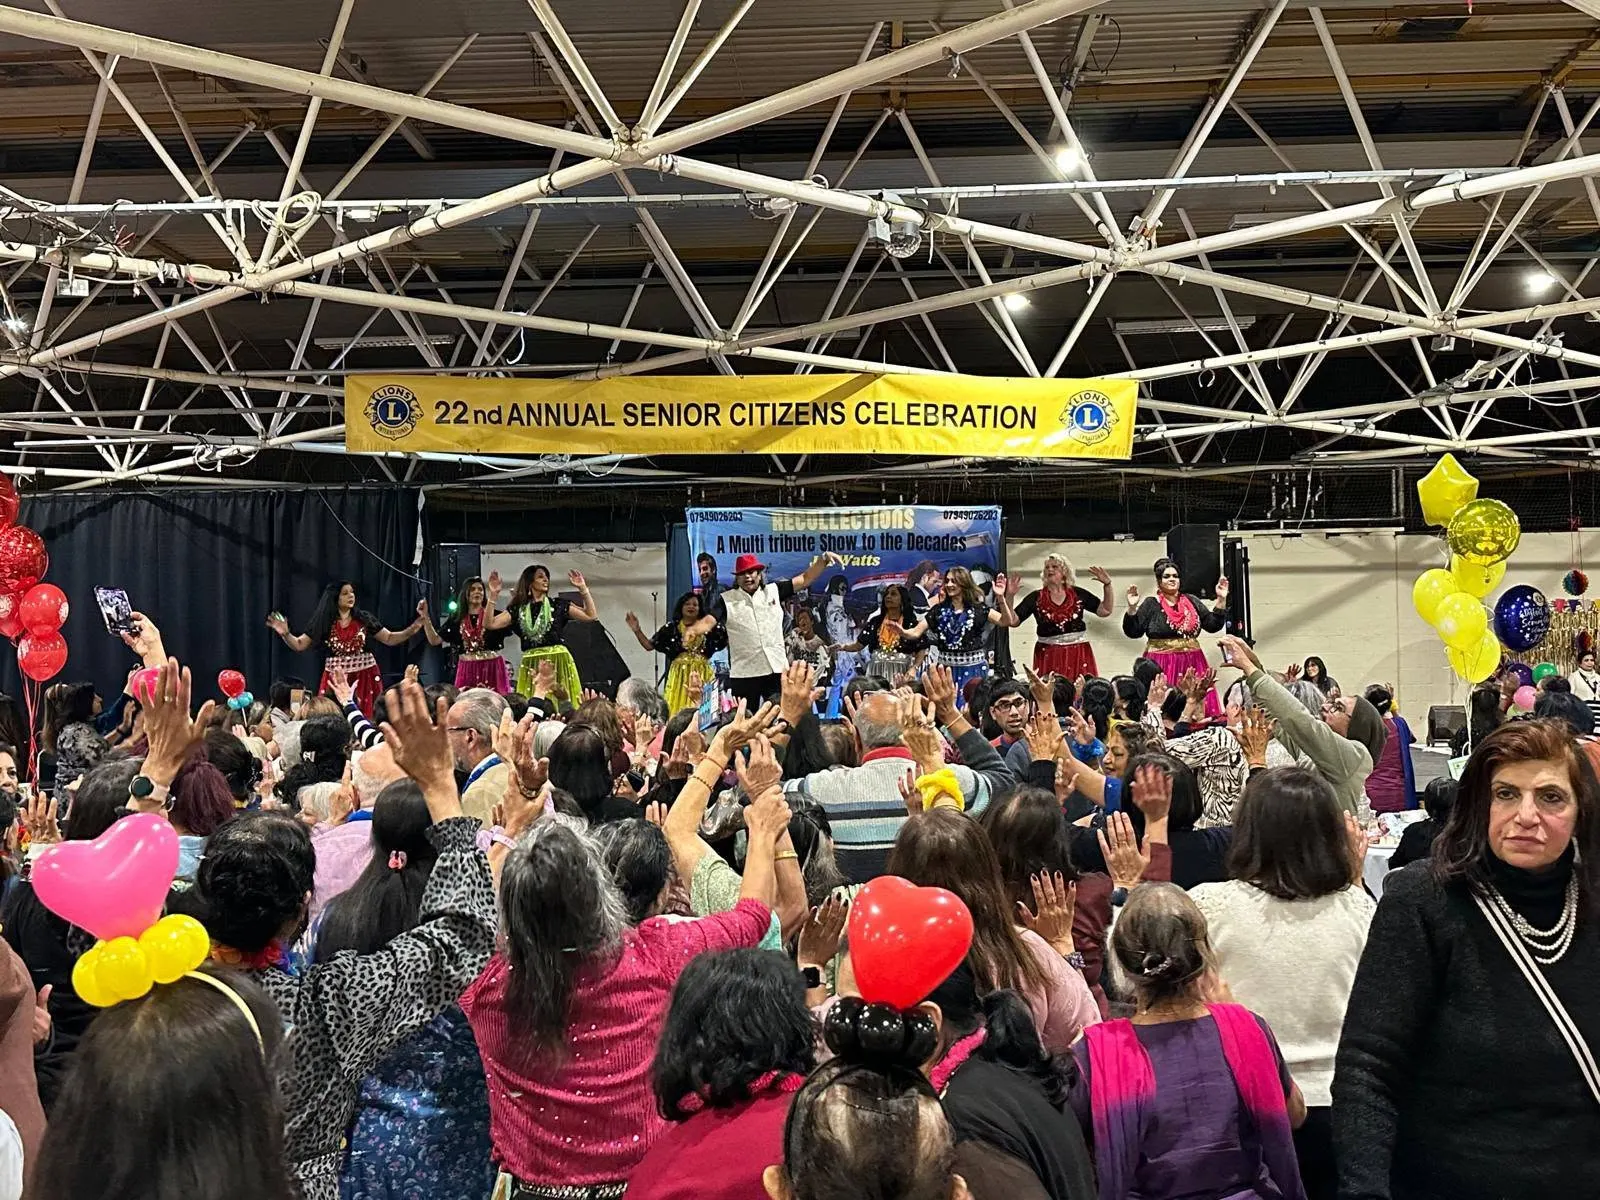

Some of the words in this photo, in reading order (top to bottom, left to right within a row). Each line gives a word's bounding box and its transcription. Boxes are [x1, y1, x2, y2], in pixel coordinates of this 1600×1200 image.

[376, 386, 411, 399] LIONS
[1073, 392, 1107, 405] LIONS
[386, 401, 402, 421] L
[434, 400, 502, 426] 22nd
[507, 402, 616, 428] ANNUAL
[622, 402, 722, 428] SENIOR
[729, 401, 846, 427] CITIZENS
[854, 401, 1037, 430] CELEBRATION
[1082, 407, 1099, 427] L
[716, 535, 725, 554] A
[729, 535, 765, 554] Multi
[768, 534, 816, 553] tribute
[819, 533, 858, 553] Show
[861, 533, 876, 551] to
[880, 533, 903, 551] the
[907, 533, 967, 552] Decades
[839, 554, 881, 567] Watts
